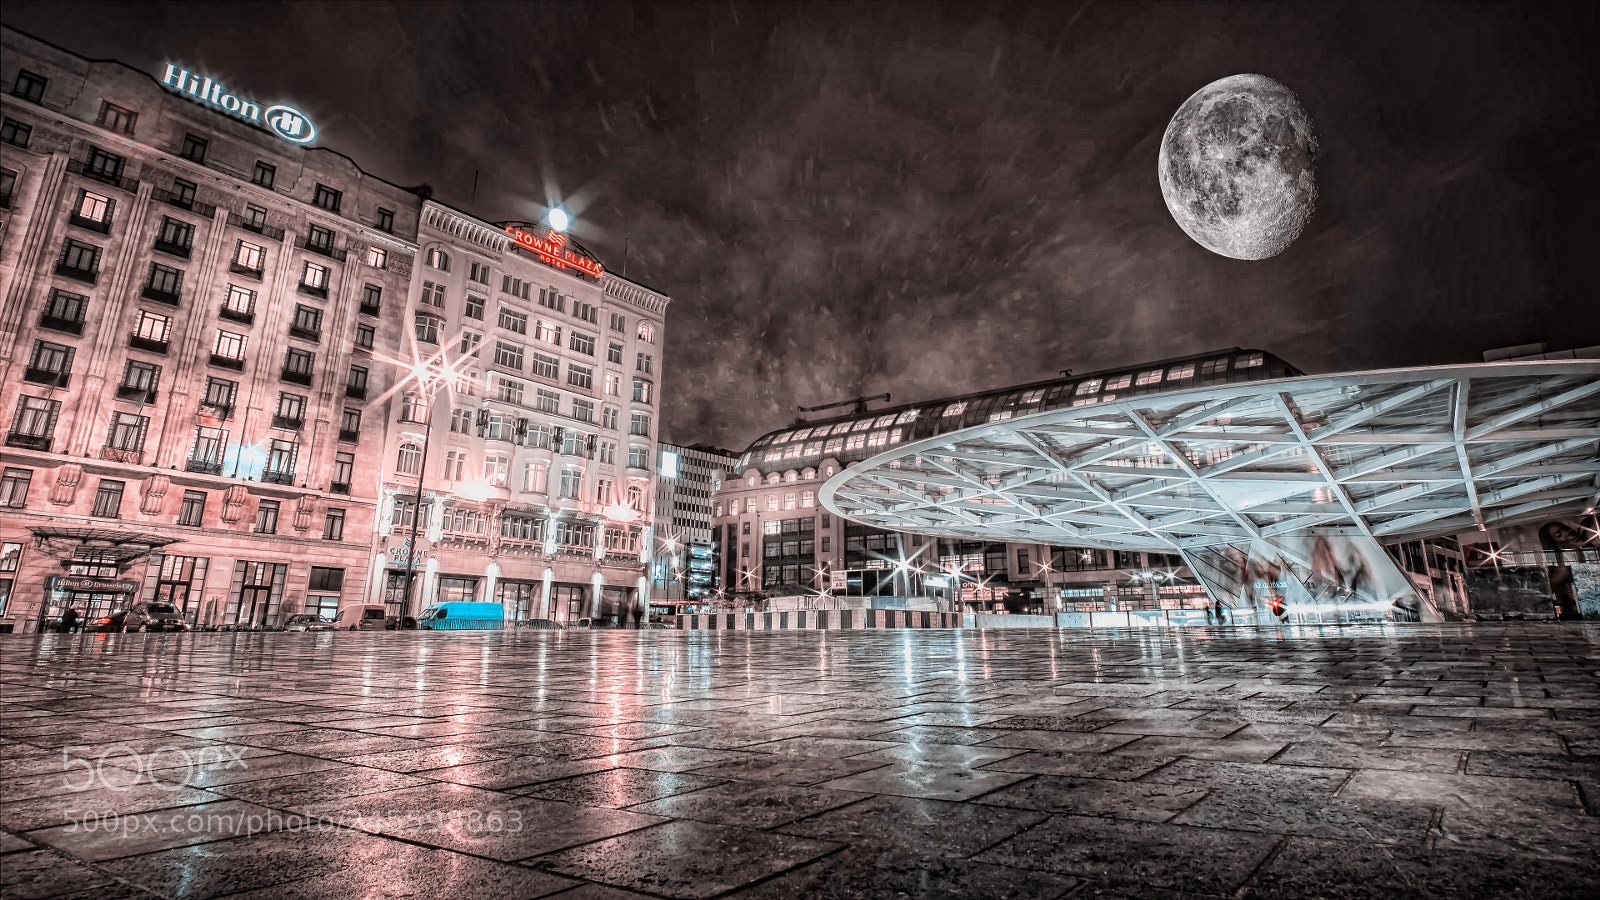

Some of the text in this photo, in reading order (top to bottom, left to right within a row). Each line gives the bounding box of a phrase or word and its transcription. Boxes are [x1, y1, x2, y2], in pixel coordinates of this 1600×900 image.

[161, 62, 261, 121] Hilton
[540, 254, 567, 270] HOTEL
[564, 250, 601, 273] PLAZA
[389, 547, 428, 558] CRONE
